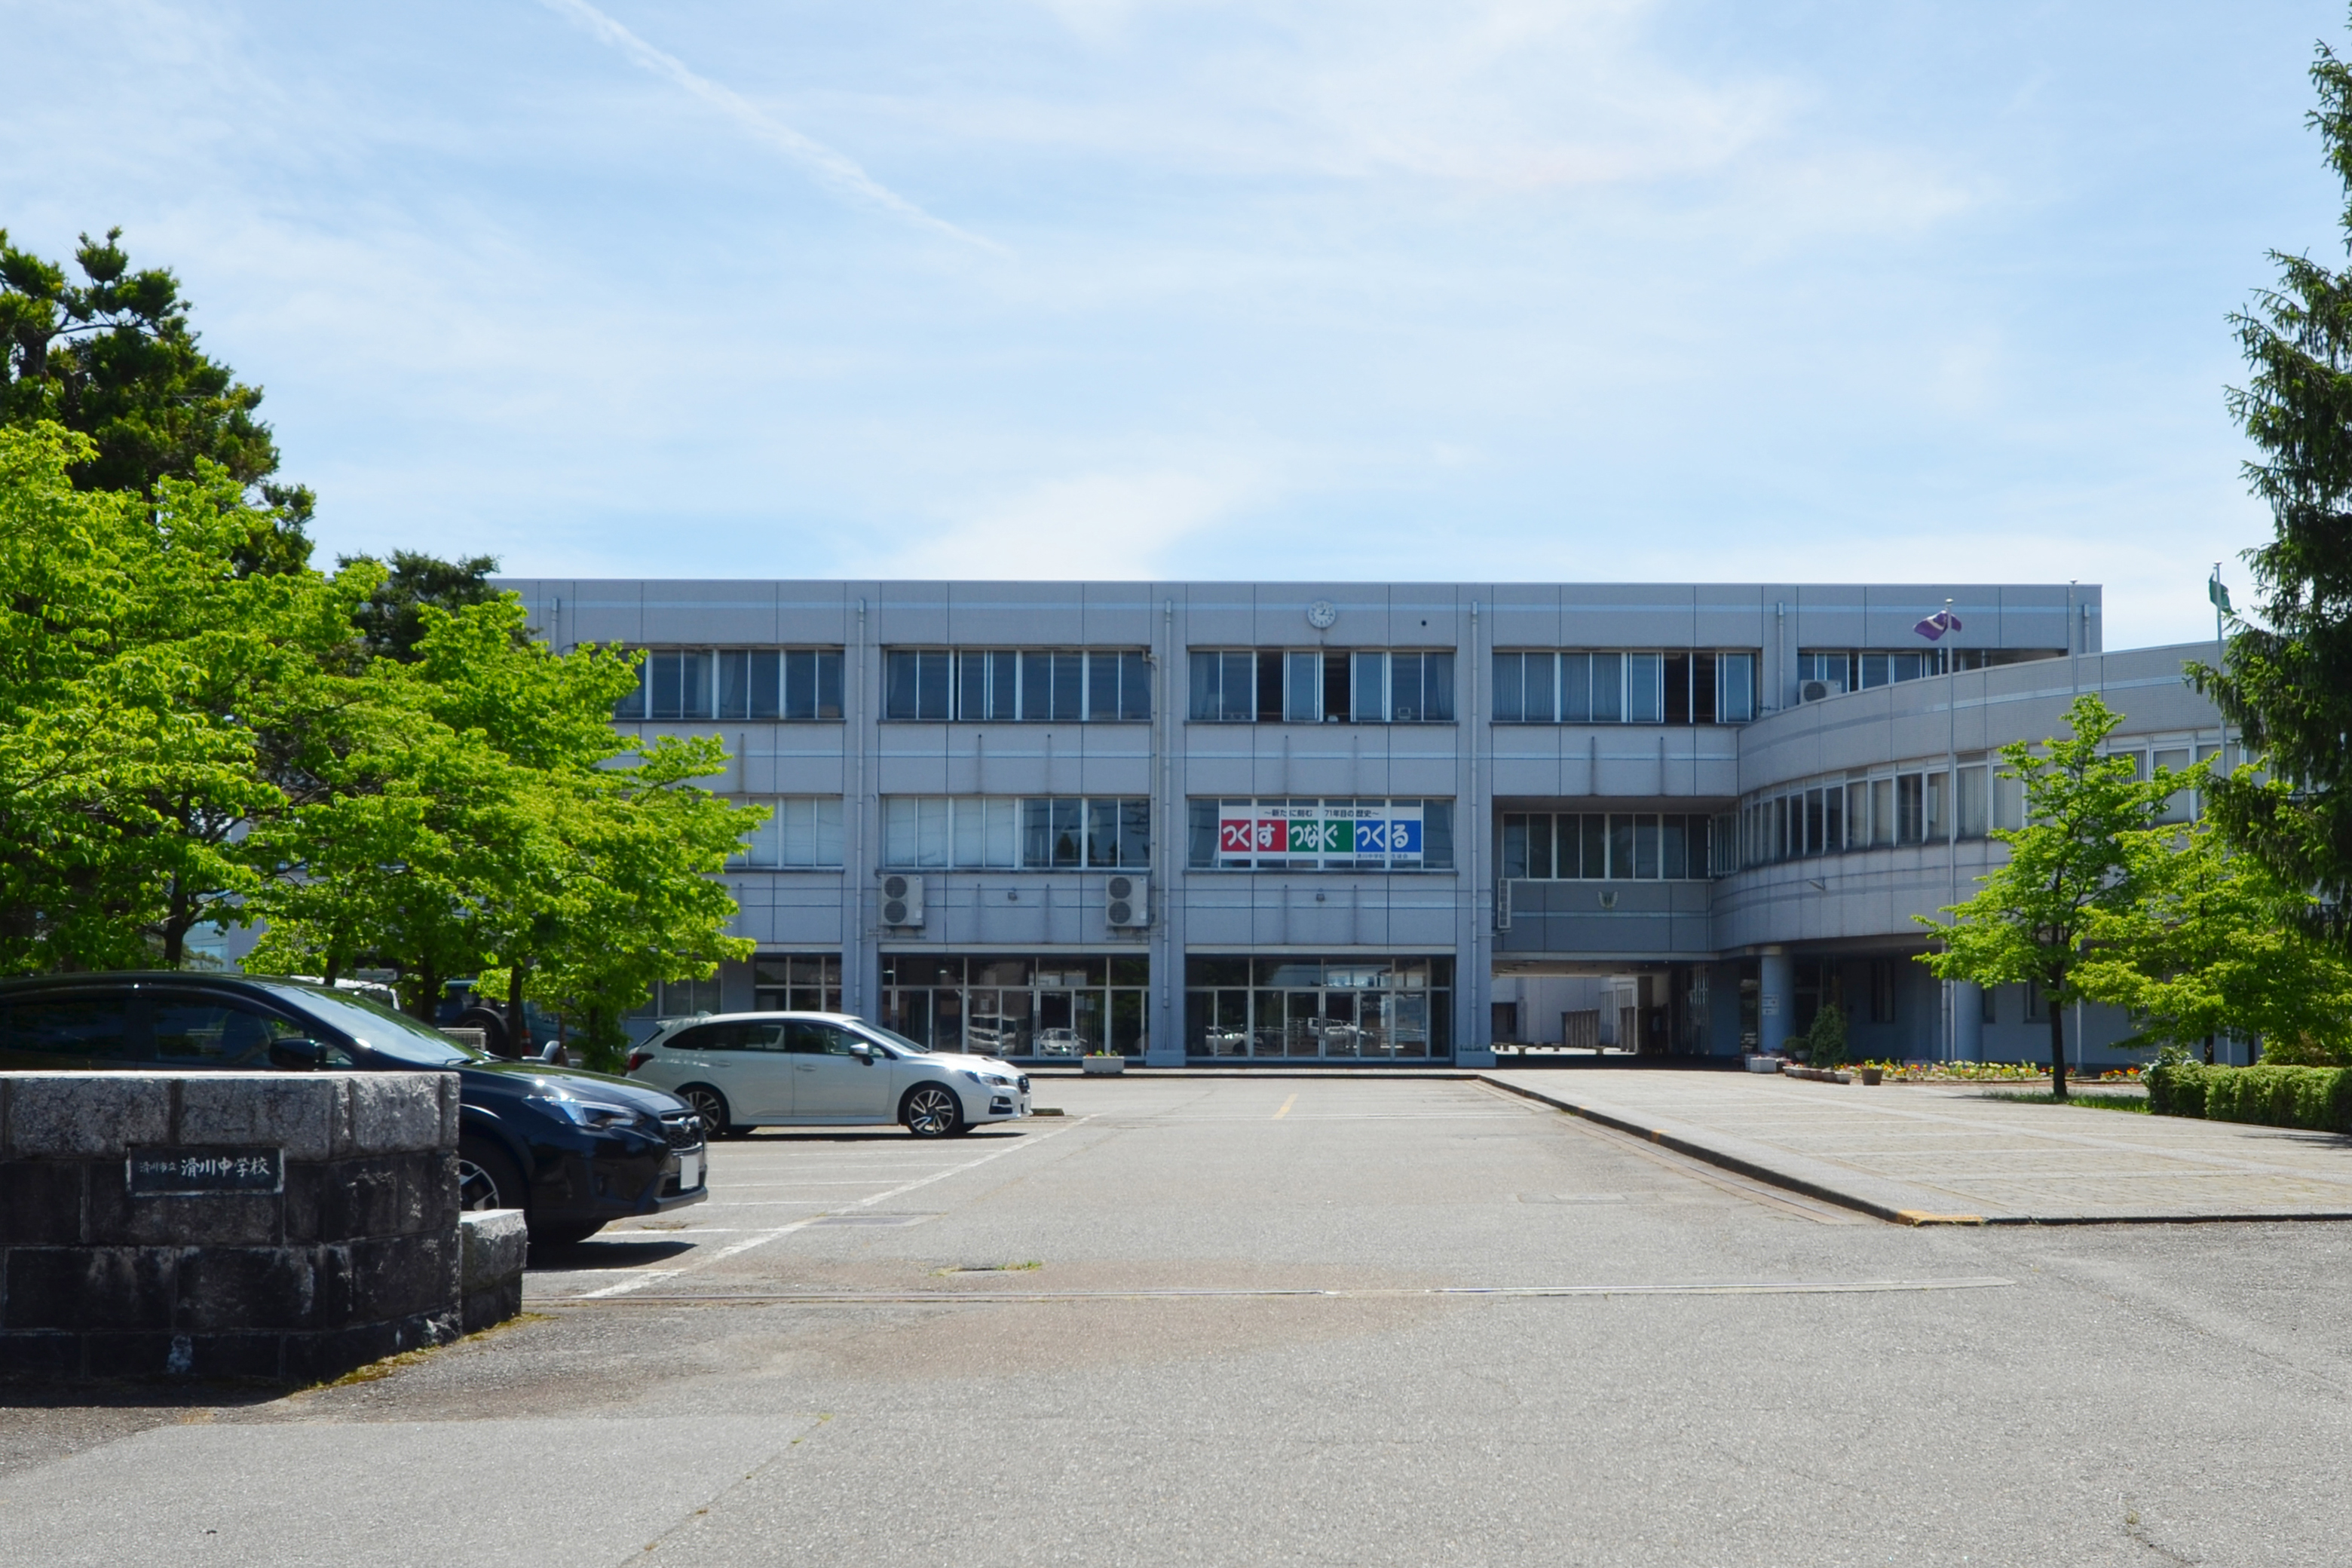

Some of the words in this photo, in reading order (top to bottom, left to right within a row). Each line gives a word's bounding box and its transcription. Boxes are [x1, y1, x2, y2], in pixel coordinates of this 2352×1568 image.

[1222, 823, 1276, 848] つくす
[1290, 823, 1339, 849] つなぐ
[1356, 824, 1409, 849] つくる
[139, 1161, 176, 1173] 滑川市立
[181, 1156, 271, 1178] 滑川中学校
